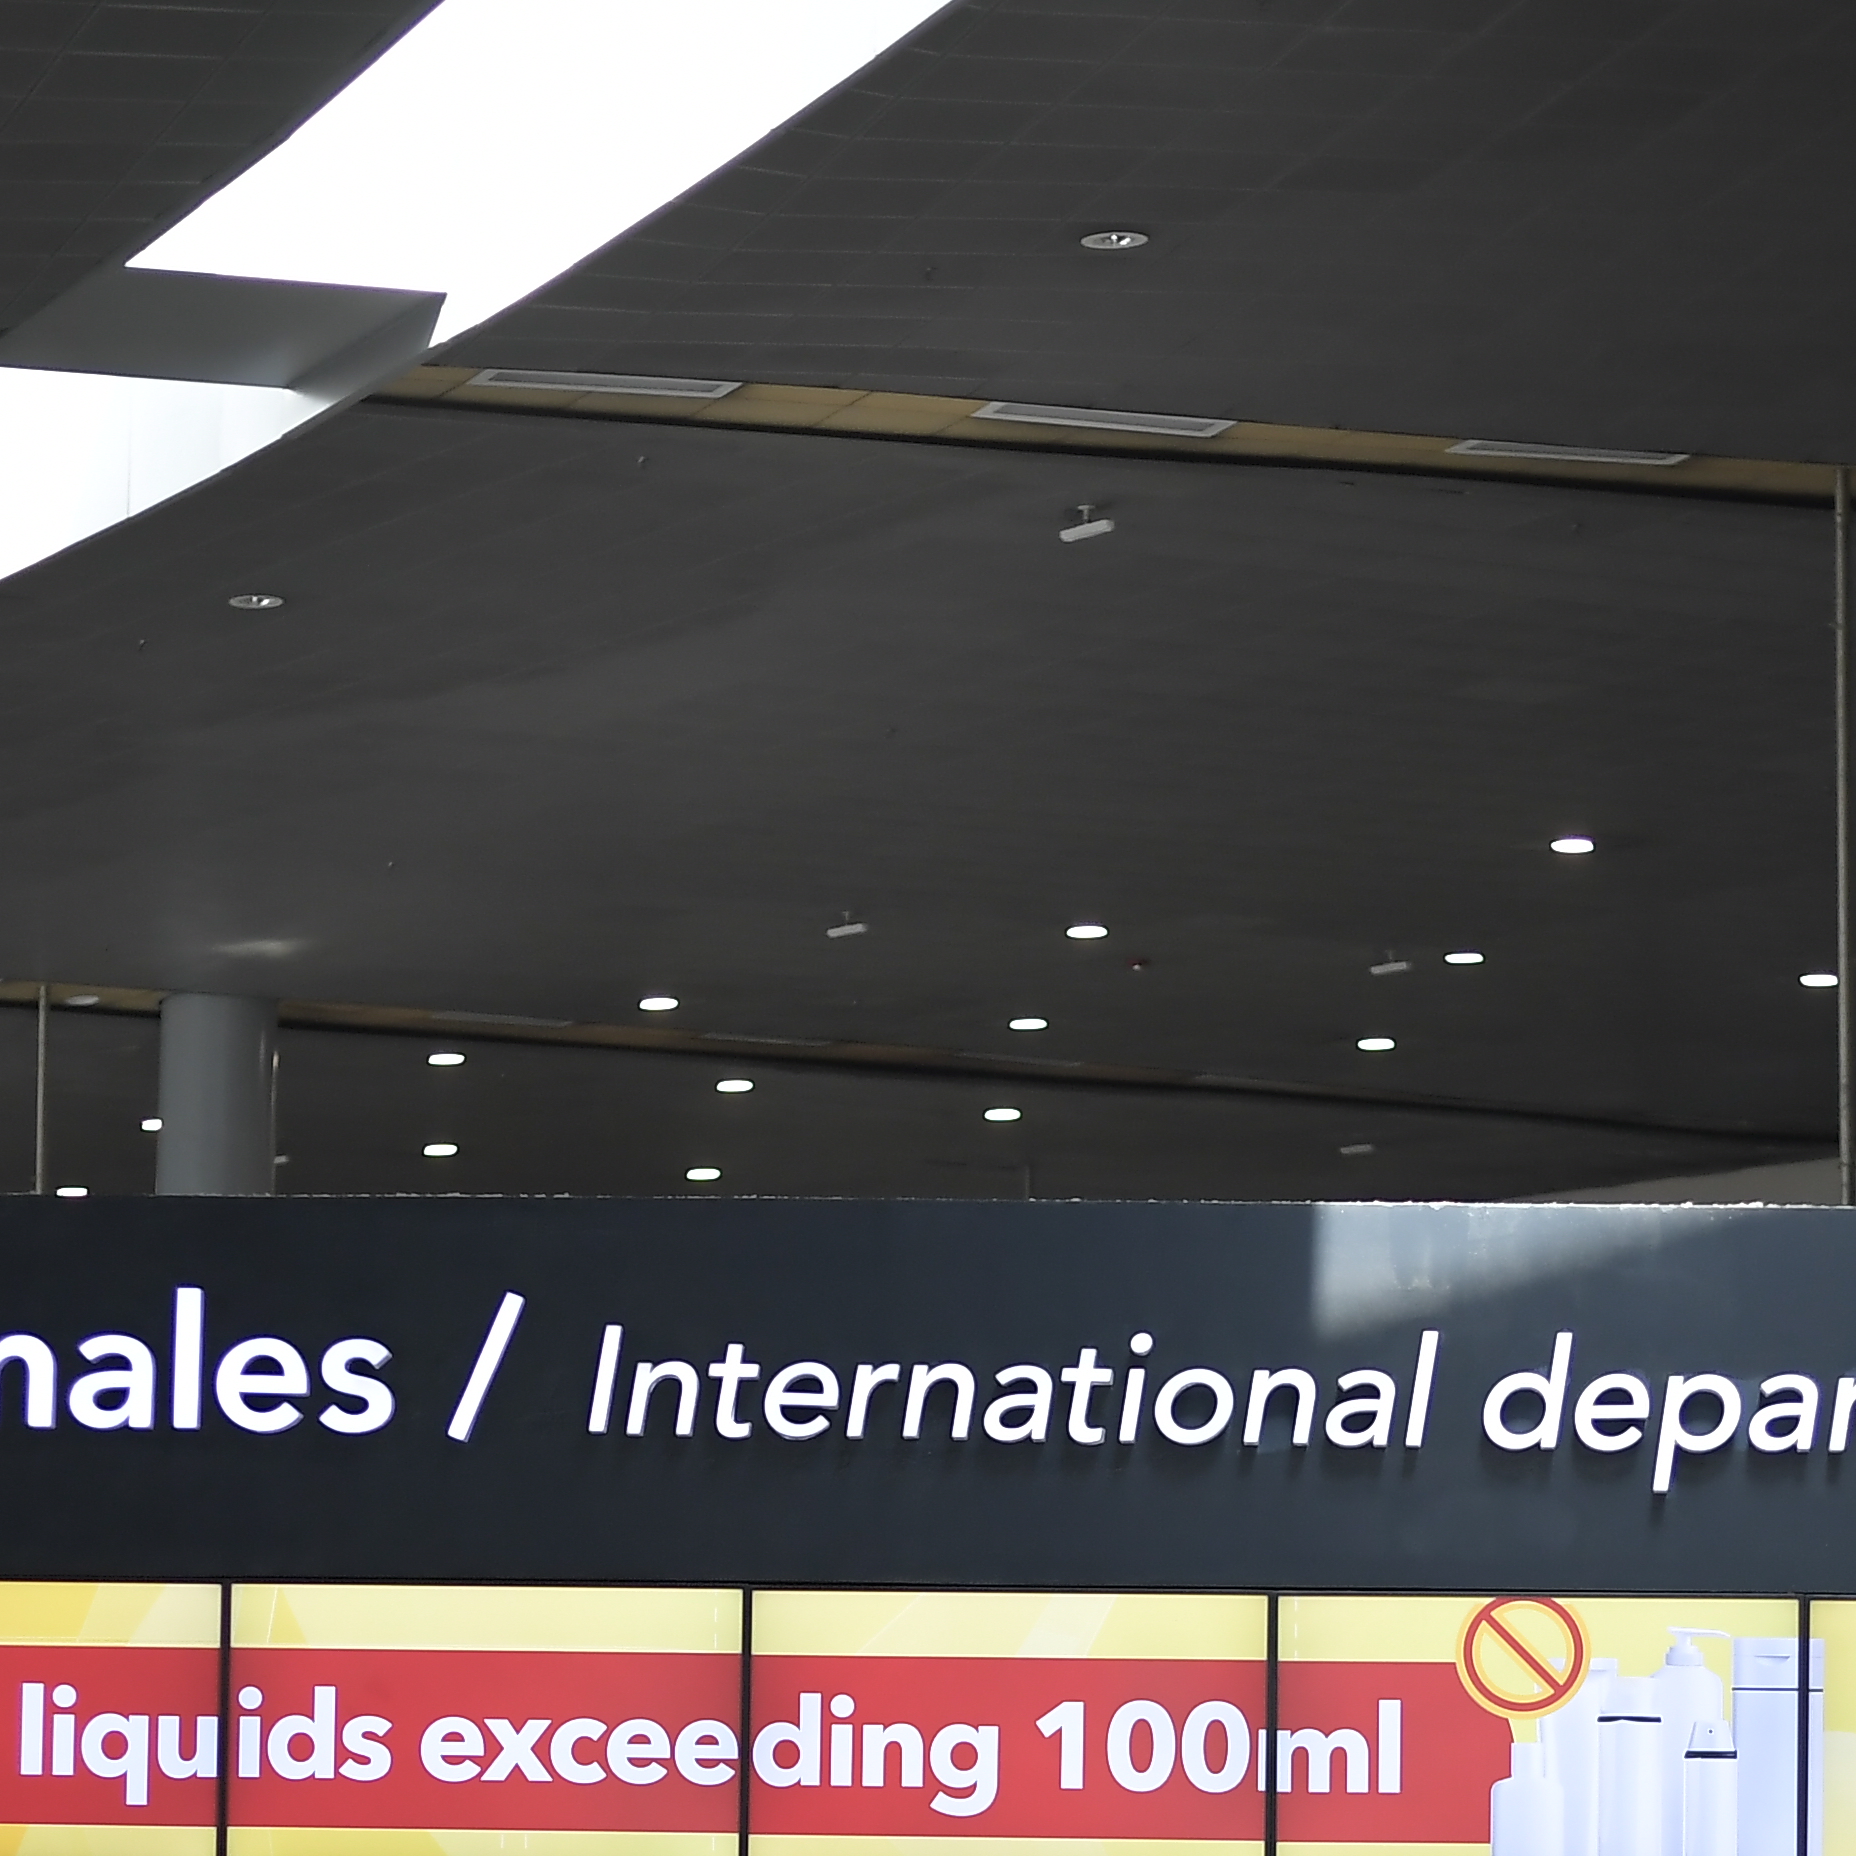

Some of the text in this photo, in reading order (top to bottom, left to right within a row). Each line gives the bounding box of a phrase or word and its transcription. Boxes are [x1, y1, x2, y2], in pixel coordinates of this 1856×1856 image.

[447, 1292, 525, 1443] /
[586, 1324, 1440, 1450] International
[20, 1682, 393, 1807] liquids
[419, 1692, 999, 1818] exceeding
[1033, 1698, 1403, 1796] 100ml
